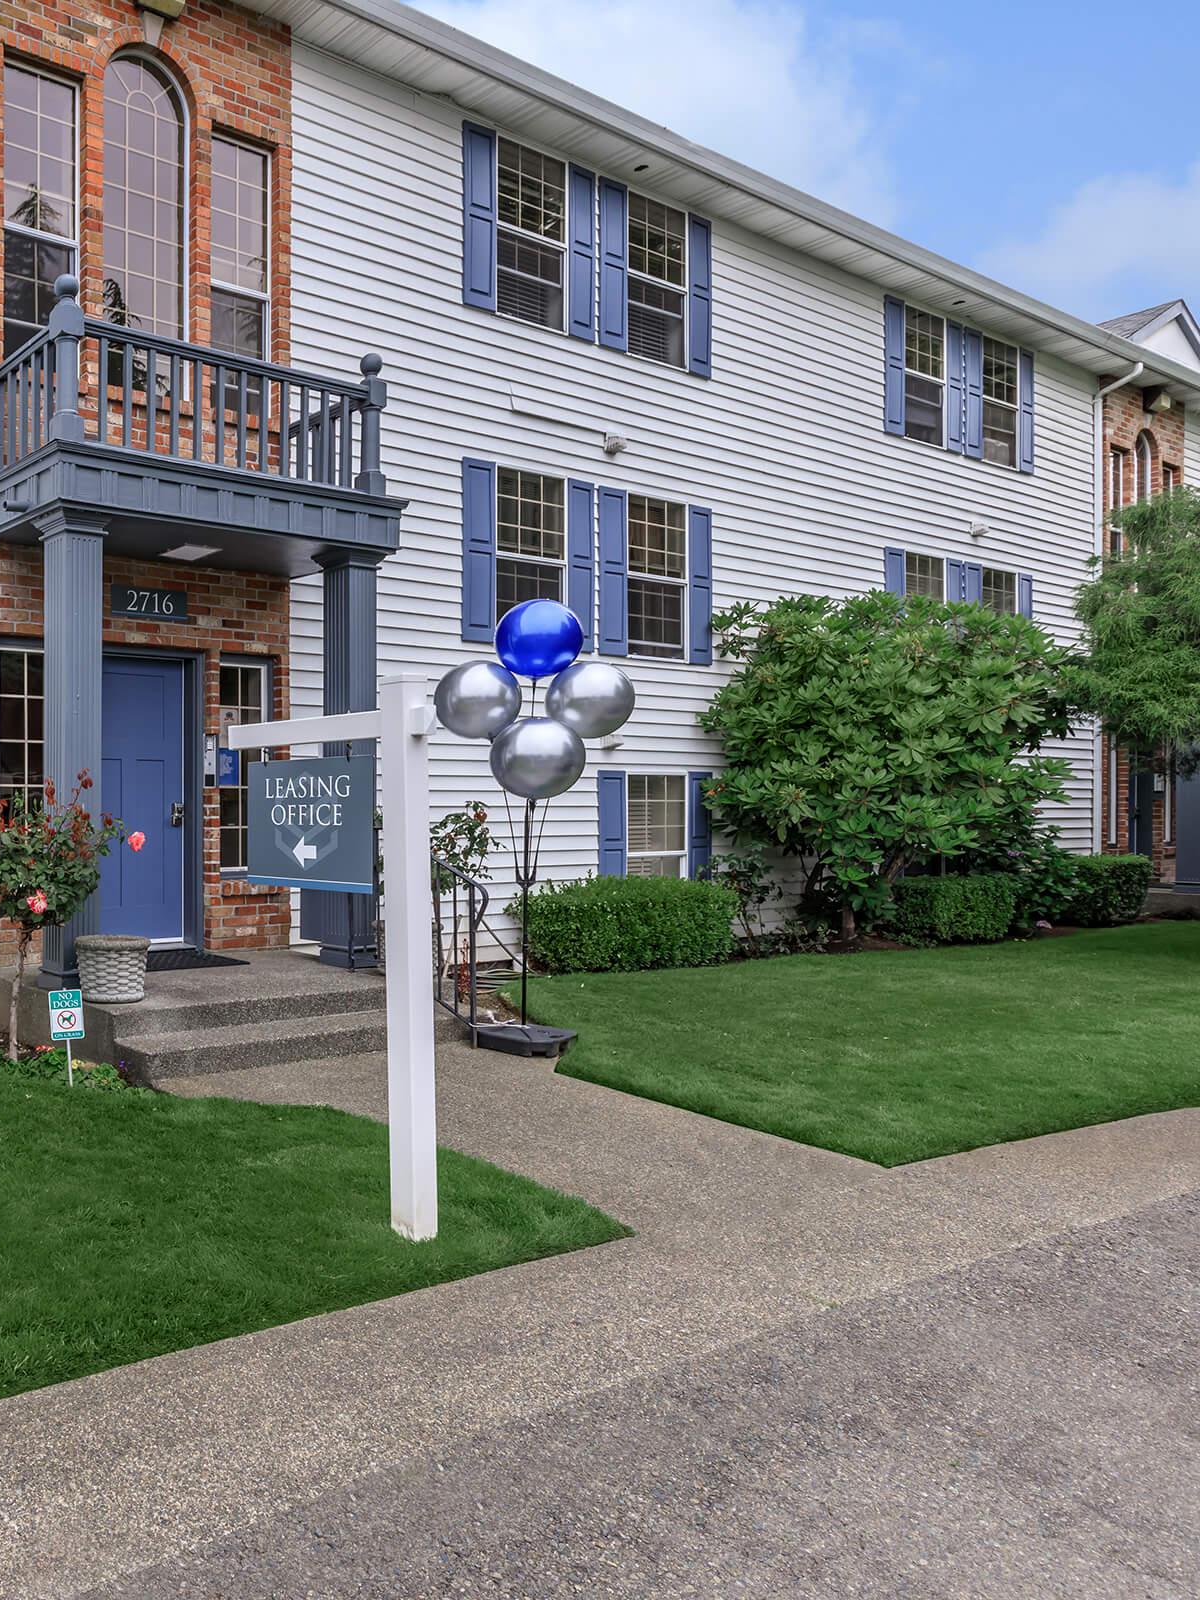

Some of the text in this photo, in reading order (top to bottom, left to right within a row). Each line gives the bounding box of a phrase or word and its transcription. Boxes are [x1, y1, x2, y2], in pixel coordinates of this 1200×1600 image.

[127, 590, 174, 615] 2716
[265, 775, 351, 799] LEASING
[271, 804, 343, 826] OFFICE
[53, 1000, 79, 1008] DOGS
[58, 992, 72, 1000] NO
